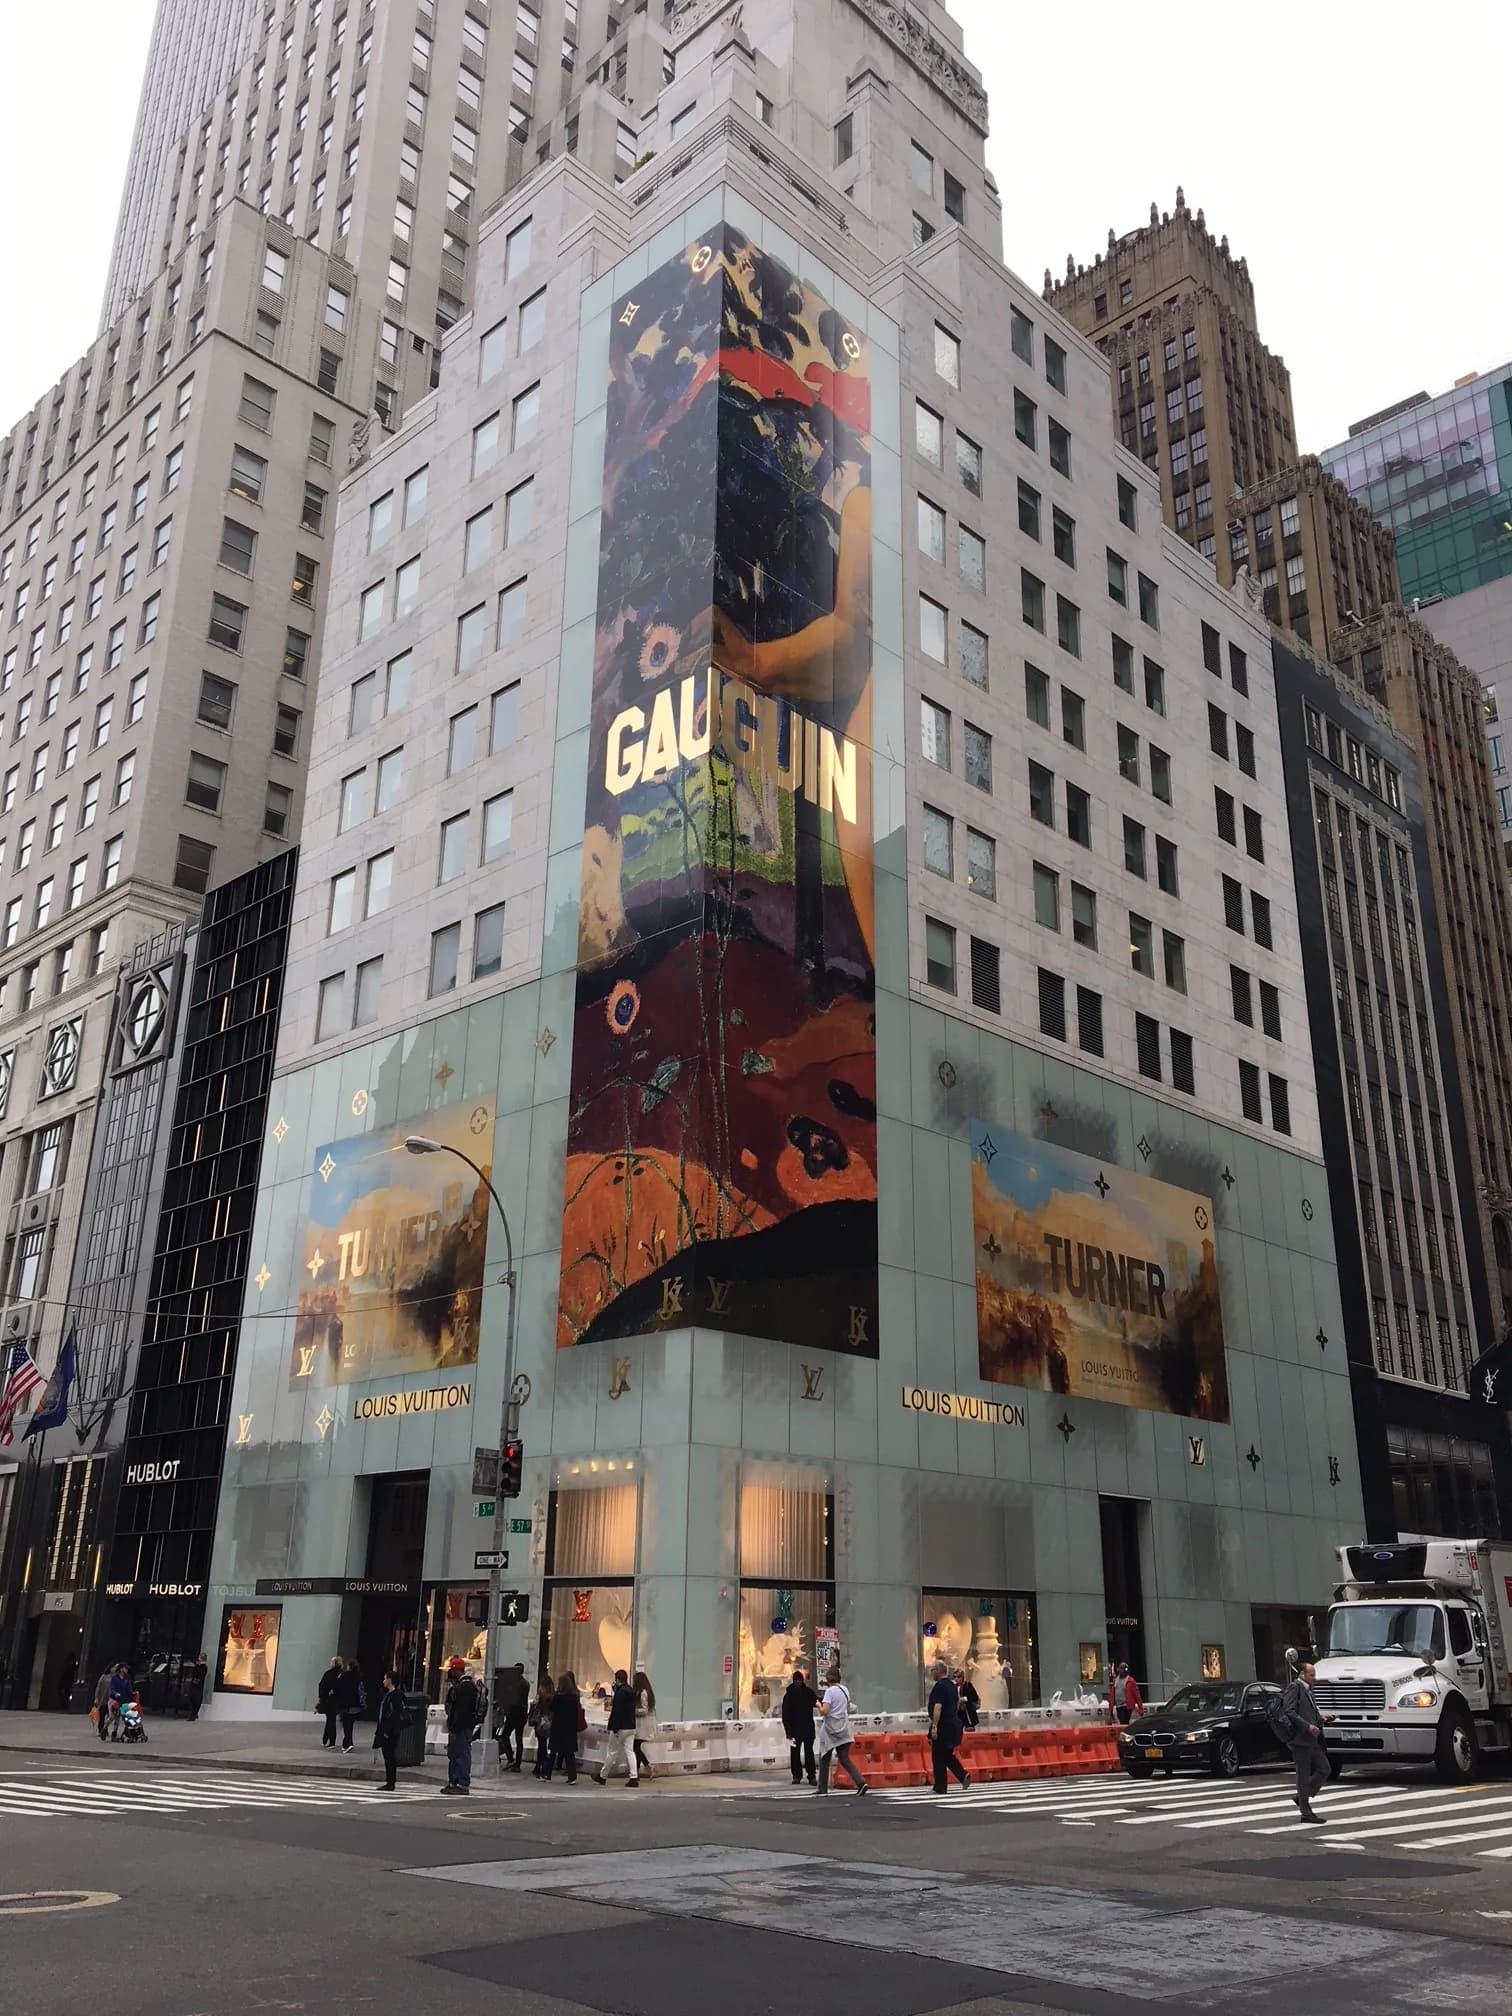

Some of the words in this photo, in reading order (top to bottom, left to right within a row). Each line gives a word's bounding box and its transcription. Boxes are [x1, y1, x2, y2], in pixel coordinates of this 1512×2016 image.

[605, 666, 857, 824] GAUGUIN
[338, 1210, 442, 1281] TUER
[1044, 1232, 1167, 1320] TURNER
[1081, 1359, 1108, 1376] LOUIS
[1109, 1365, 1143, 1384] VUITTO
[354, 1394, 398, 1420] LOUIS
[403, 1384, 471, 1413] VUITTON
[902, 1386, 951, 1415] LOUIS
[956, 1396, 1025, 1427] VUITTON
[126, 1460, 180, 1484] HUBLOT
[516, 1520, 525, 1532] 57
[106, 1583, 134, 1595] HUBLOT
[149, 1584, 202, 1596] HUBLOT
[345, 1582, 371, 1592] LOUIS
[372, 1583, 408, 1593] VUITTON
